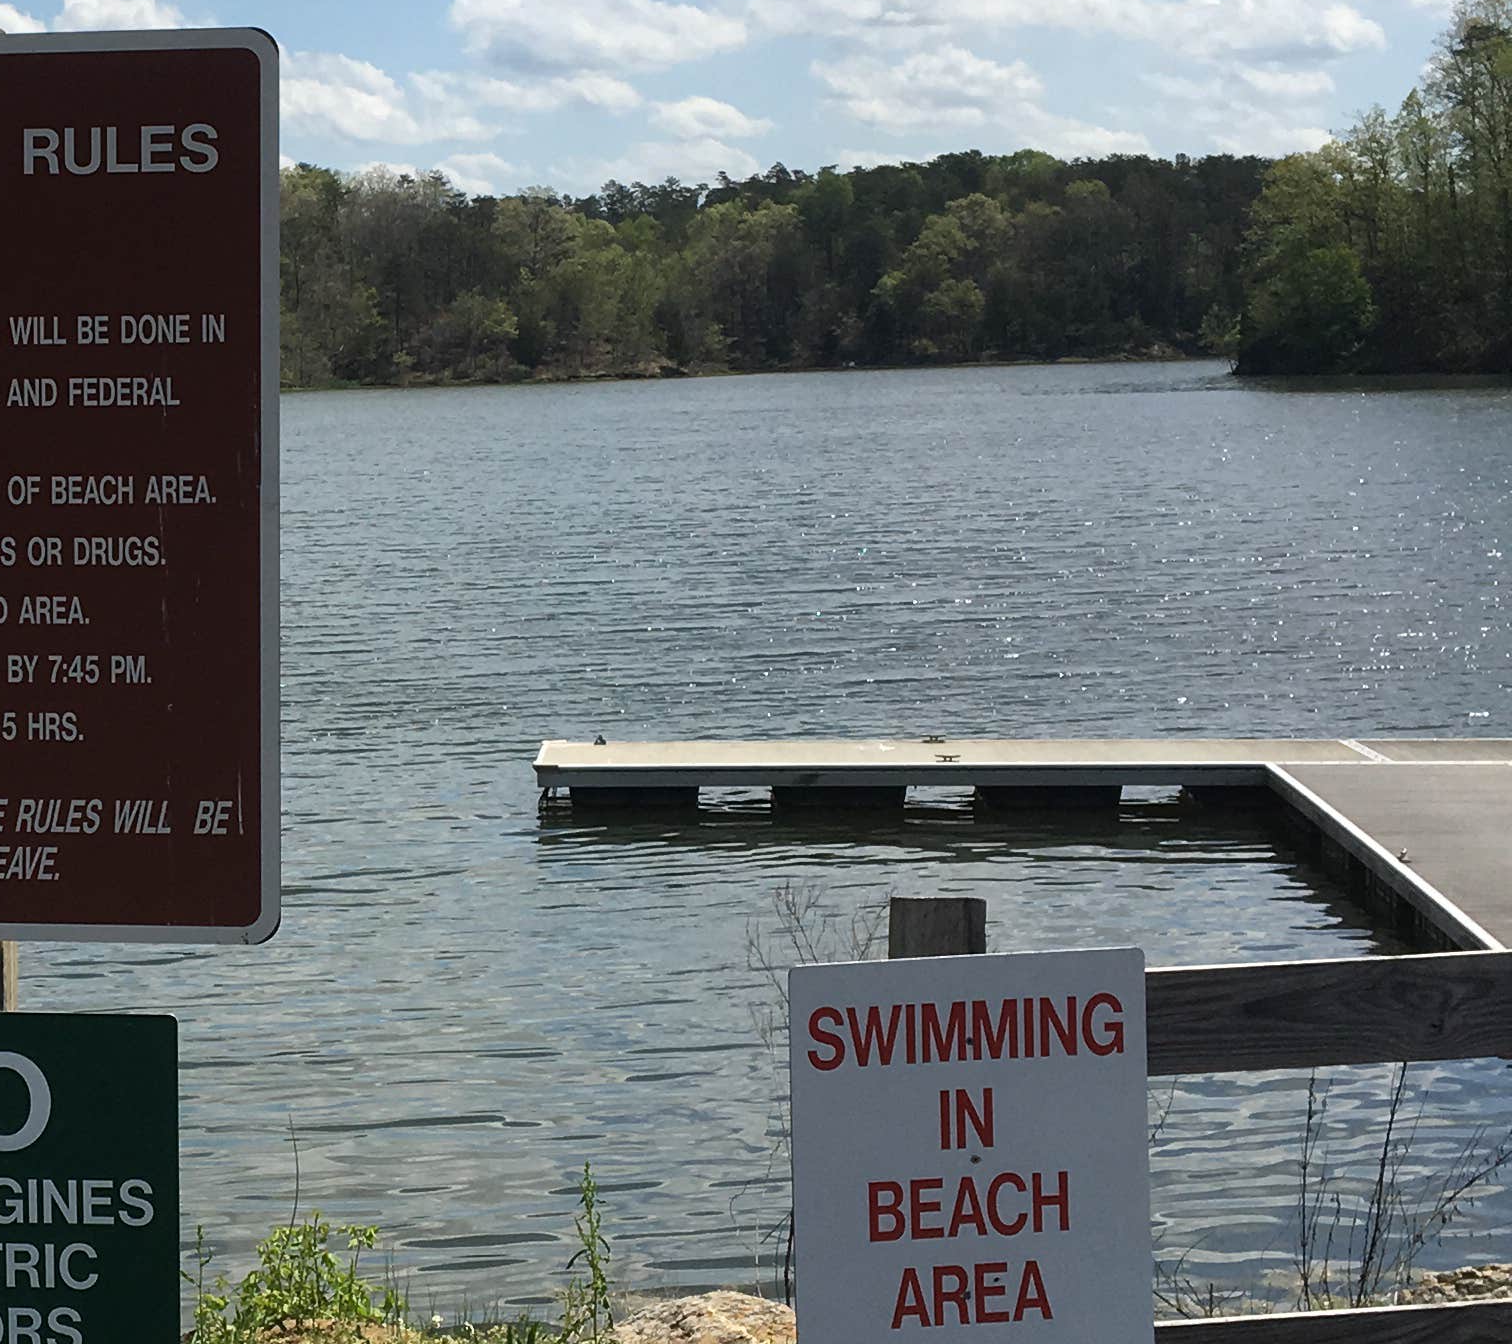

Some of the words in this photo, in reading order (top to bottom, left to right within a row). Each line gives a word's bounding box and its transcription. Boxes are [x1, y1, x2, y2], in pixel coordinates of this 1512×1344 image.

[23, 123, 219, 175] RULES
[10, 316, 66, 345] WILL
[77, 315, 109, 344] BE
[120, 314, 190, 344] DONE
[201, 313, 226, 343] IN
[6, 378, 57, 407] AND
[68, 377, 180, 406] FEDERAL
[7, 476, 40, 505] OF
[51, 476, 134, 505] BEACH
[145, 475, 216, 504] AREA.
[27, 537, 62, 566] OR
[73, 537, 167, 566] DRUGS.
[19, 596, 89, 625] AREA.
[7, 655, 38, 684] BY
[48, 655, 100, 684] 7:45
[111, 656, 152, 684] PM.
[2, 712, 17, 741] 5
[28, 713, 84, 741] HRS.
[16, 799, 102, 834] RULES
[113, 800, 172, 834] WILL
[193, 801, 232, 835] BE
[808, 993, 1124, 1071] SWIMMING
[940, 1087, 994, 1150] IN
[868, 1171, 1070, 1242] BEACH
[891, 1260, 1053, 1329] AREA
